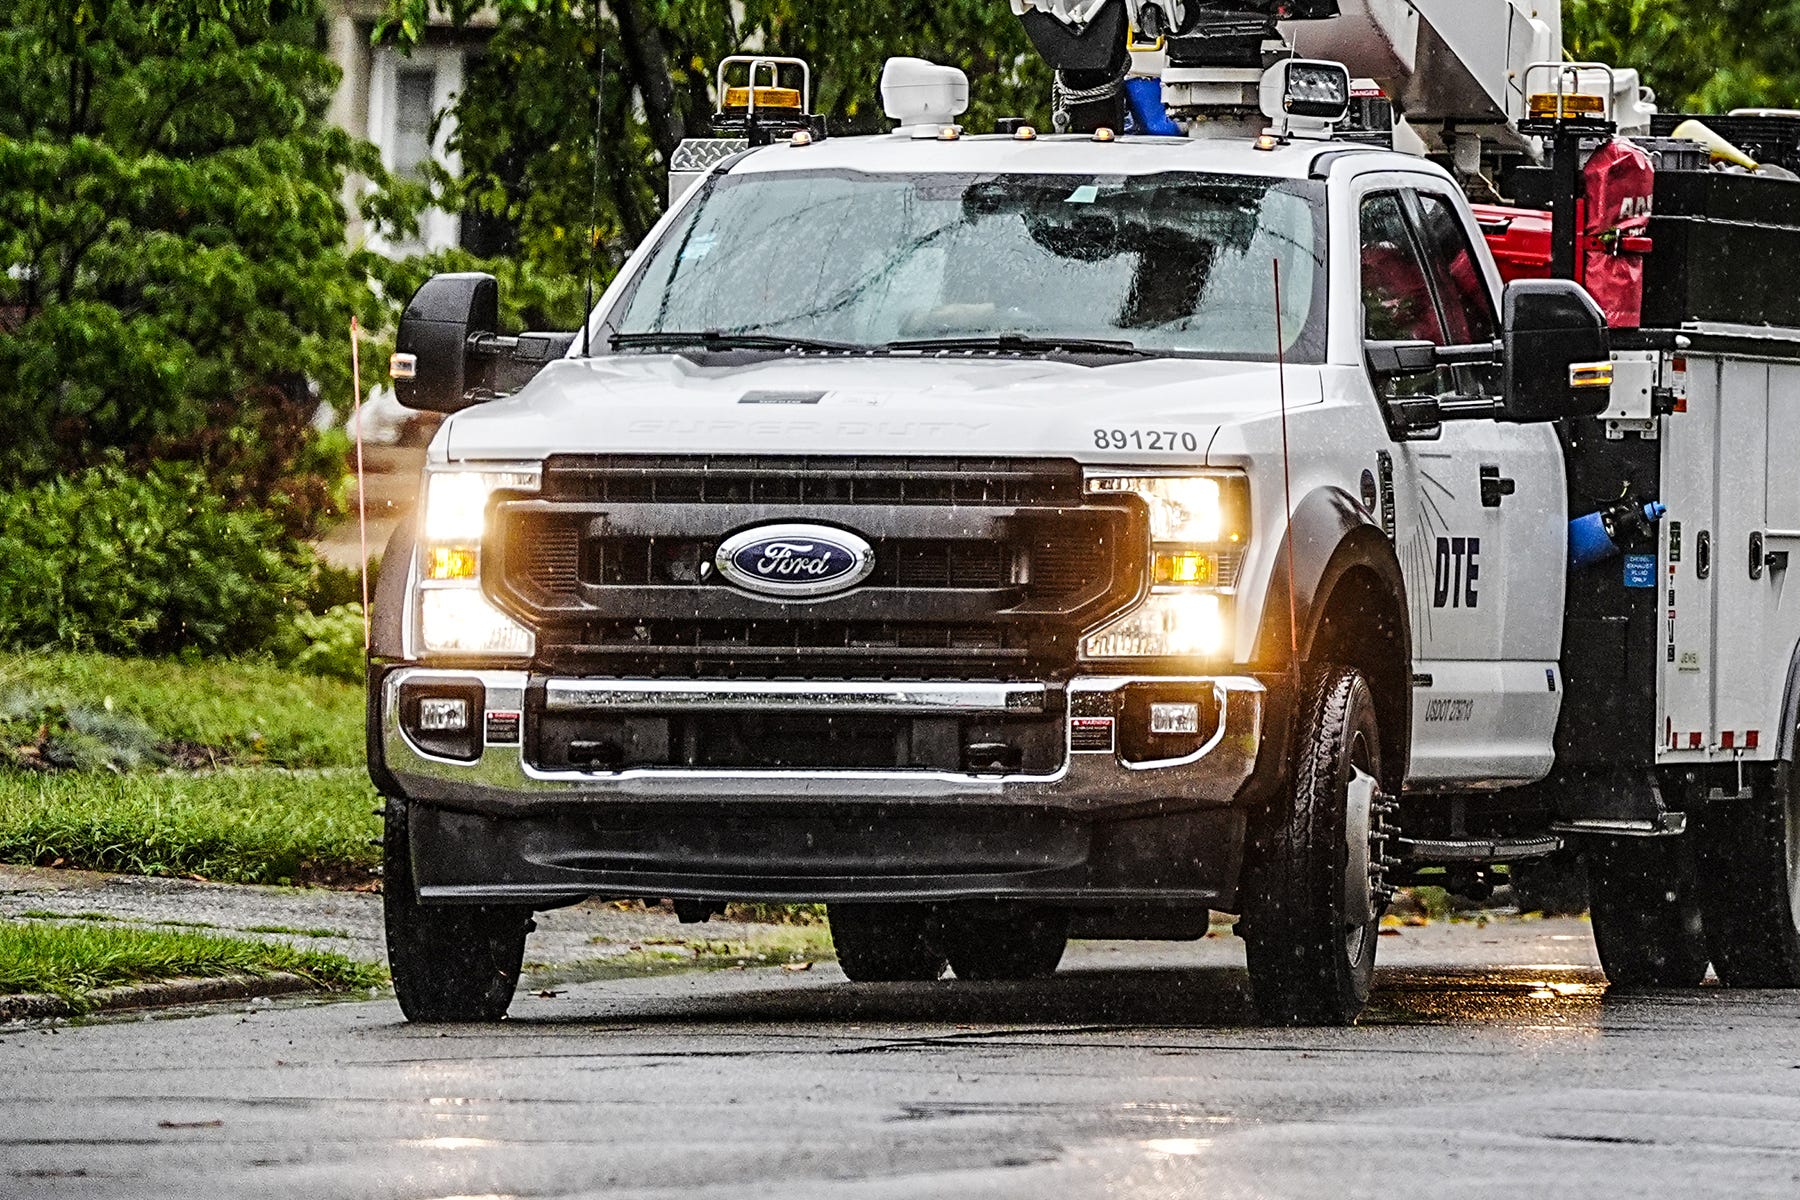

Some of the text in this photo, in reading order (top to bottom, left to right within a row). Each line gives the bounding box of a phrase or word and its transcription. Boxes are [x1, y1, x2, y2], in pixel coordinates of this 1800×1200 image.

[1093, 429, 1198, 452] 891270
[757, 542, 832, 575] Ford
[1433, 537, 1480, 608] DTE
